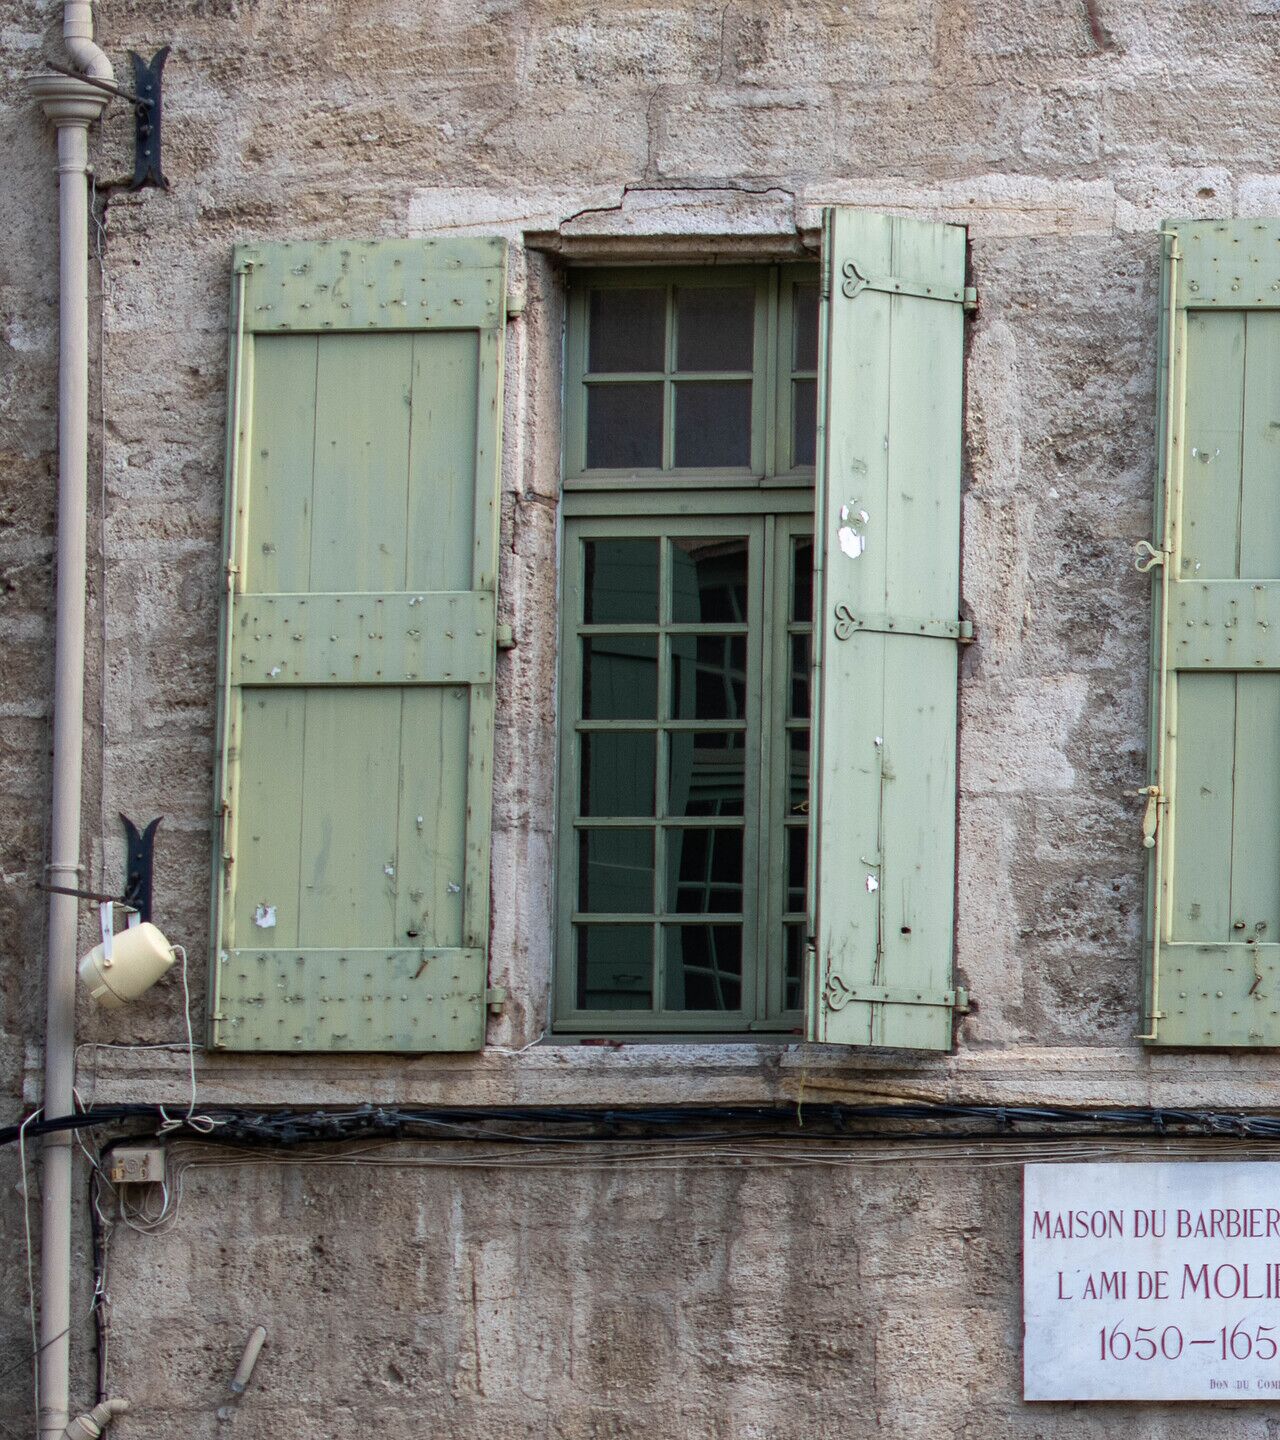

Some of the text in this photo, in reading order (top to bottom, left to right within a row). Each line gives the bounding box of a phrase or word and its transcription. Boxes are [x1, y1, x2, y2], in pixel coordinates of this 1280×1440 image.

[1032, 1209, 1124, 1239] MAISON
[1133, 1210, 1167, 1239] DU
[1177, 1208, 1280, 1239] BARBIER
[1138, 1271, 1169, 1300] DE
[1236, 1378, 1250, 1390] DU
